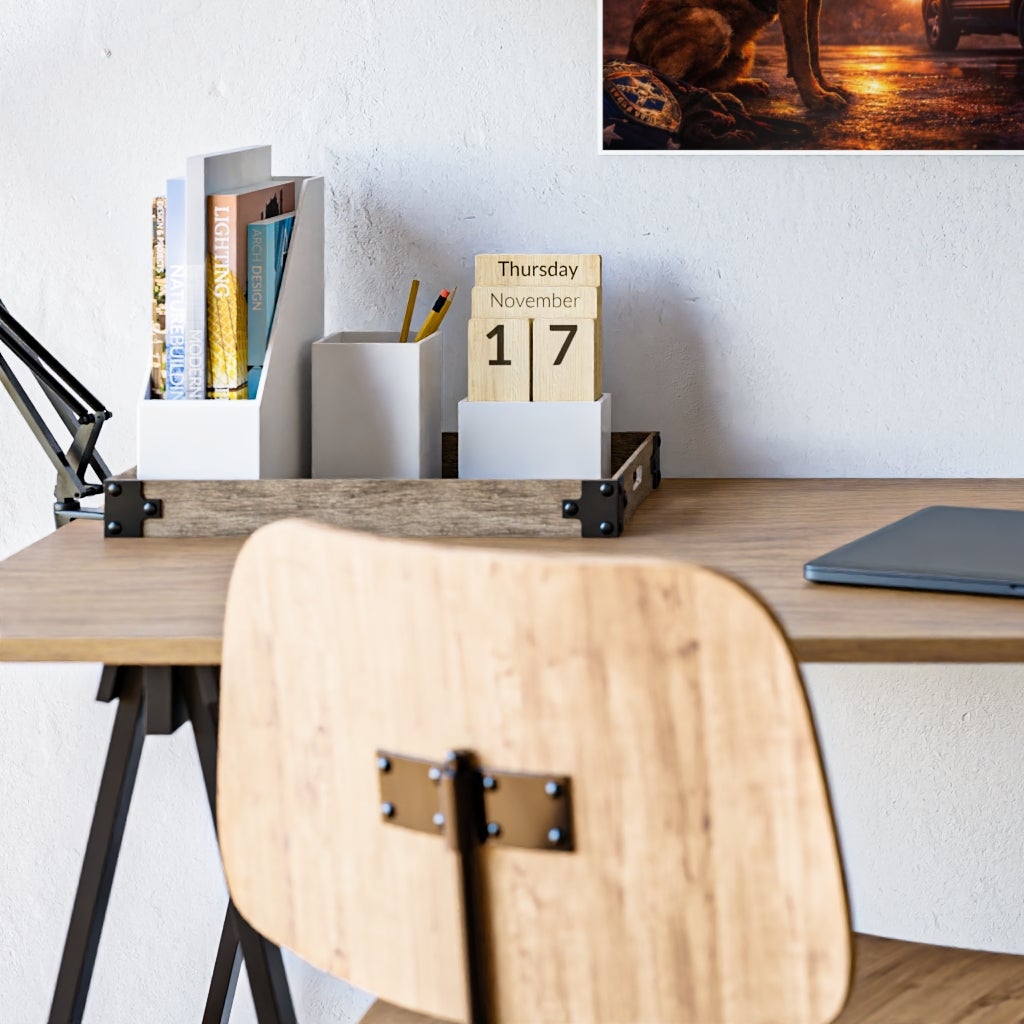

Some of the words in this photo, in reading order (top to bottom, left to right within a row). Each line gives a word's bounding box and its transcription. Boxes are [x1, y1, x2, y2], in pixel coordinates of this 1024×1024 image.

[214, 206, 230, 298] LIGHTING
[252, 229, 263, 265] ARCH
[252, 265, 263, 311] DESIGN
[498, 261, 578, 280] Thursday
[490, 292, 581, 308] November
[188, 328, 202, 399] MODERN
